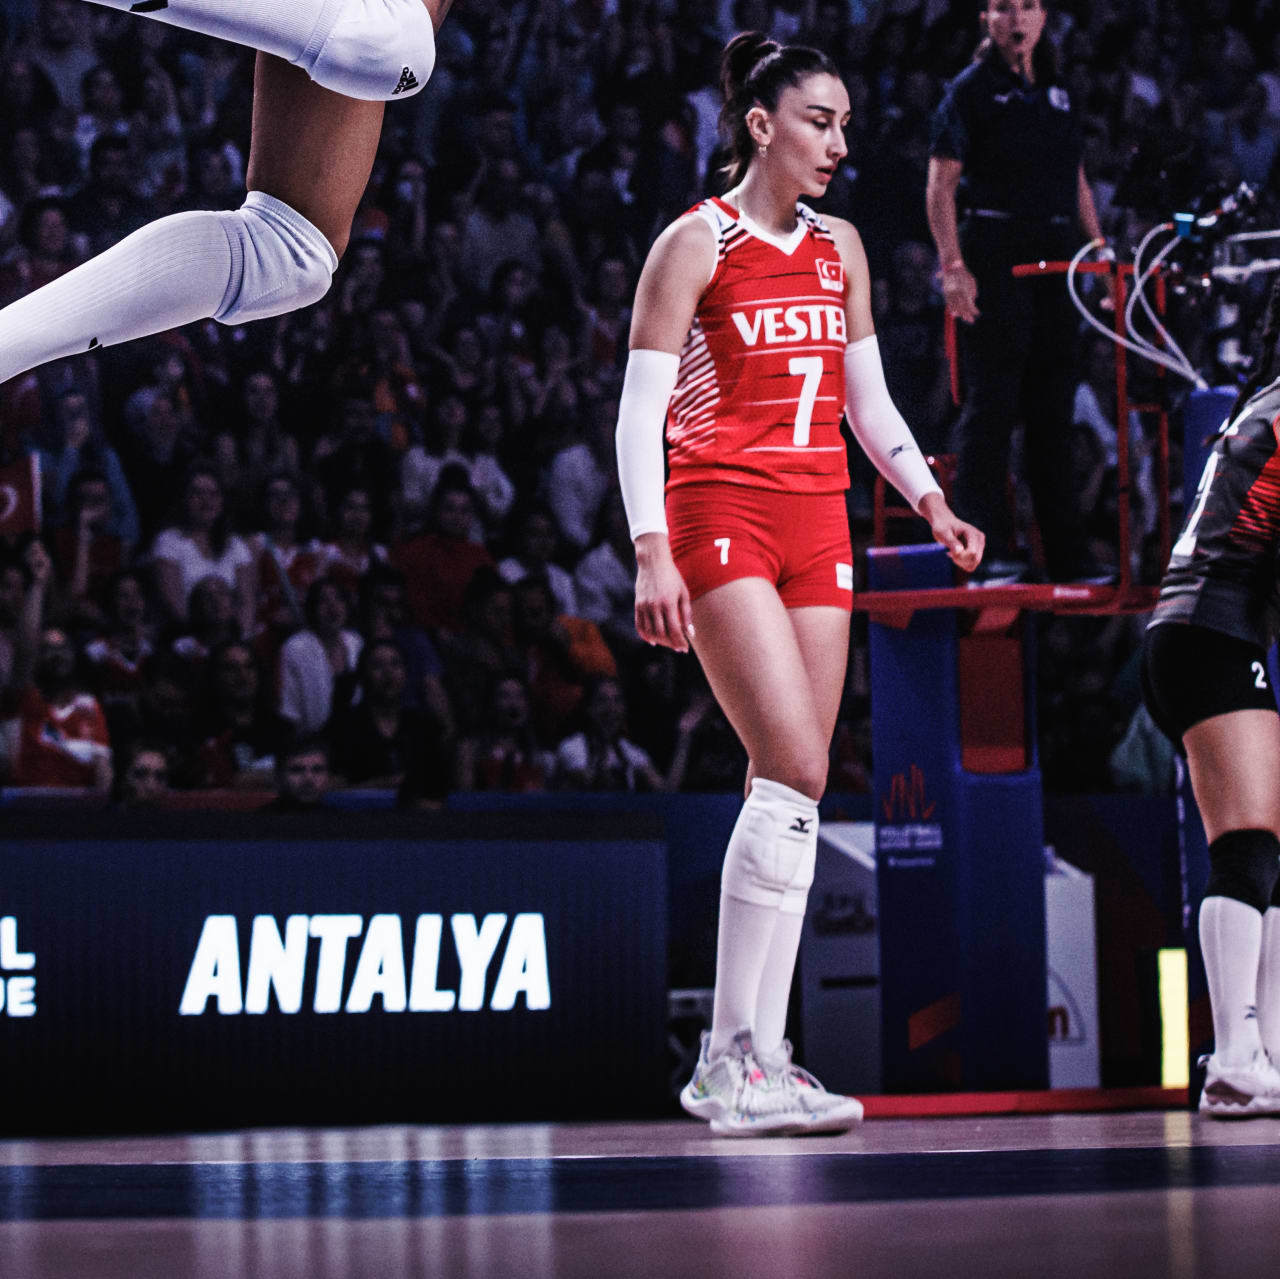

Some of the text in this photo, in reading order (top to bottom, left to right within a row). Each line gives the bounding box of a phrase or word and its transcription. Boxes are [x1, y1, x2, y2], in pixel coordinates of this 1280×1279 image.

[731, 304, 847, 347] VESTE
[788, 356, 824, 447] 7
[713, 537, 731, 566] 7
[1250, 660, 1268, 690] 2
[179, 912, 552, 1017] ANTALYA
